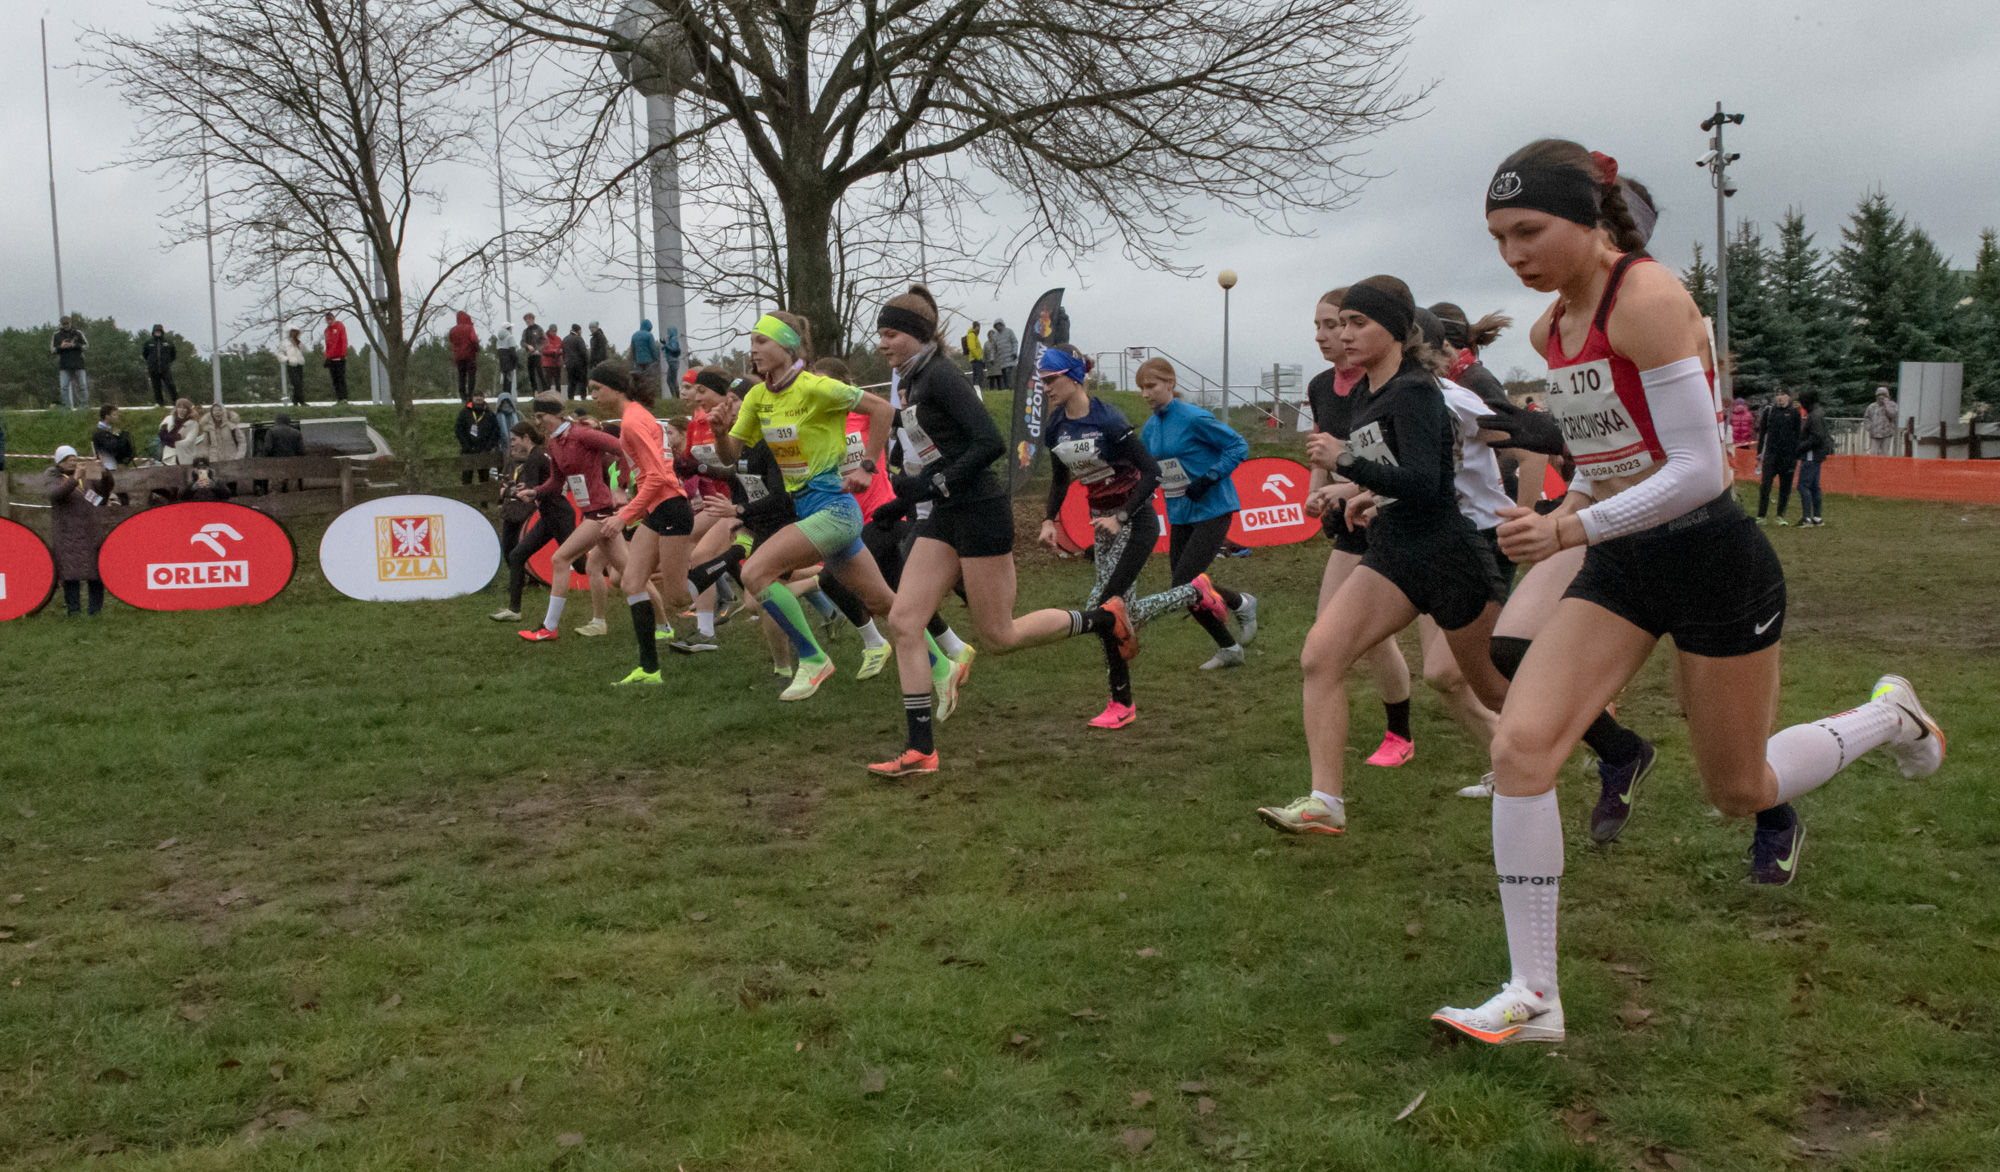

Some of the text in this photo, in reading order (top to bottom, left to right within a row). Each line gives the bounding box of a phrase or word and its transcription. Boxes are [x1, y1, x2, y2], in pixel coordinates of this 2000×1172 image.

[1570, 368, 1601, 395] 170
[785, 407, 808, 418] KGHM
[777, 427, 793, 439] 319
[1073, 441, 1090, 453] 248
[1591, 464, 1614, 477] GÓRA
[1614, 458, 1641, 473] 2023
[1244, 507, 1300, 527] ORLEN
[153, 564, 242, 585] ORLEN
[381, 558, 444, 578] PZLA
